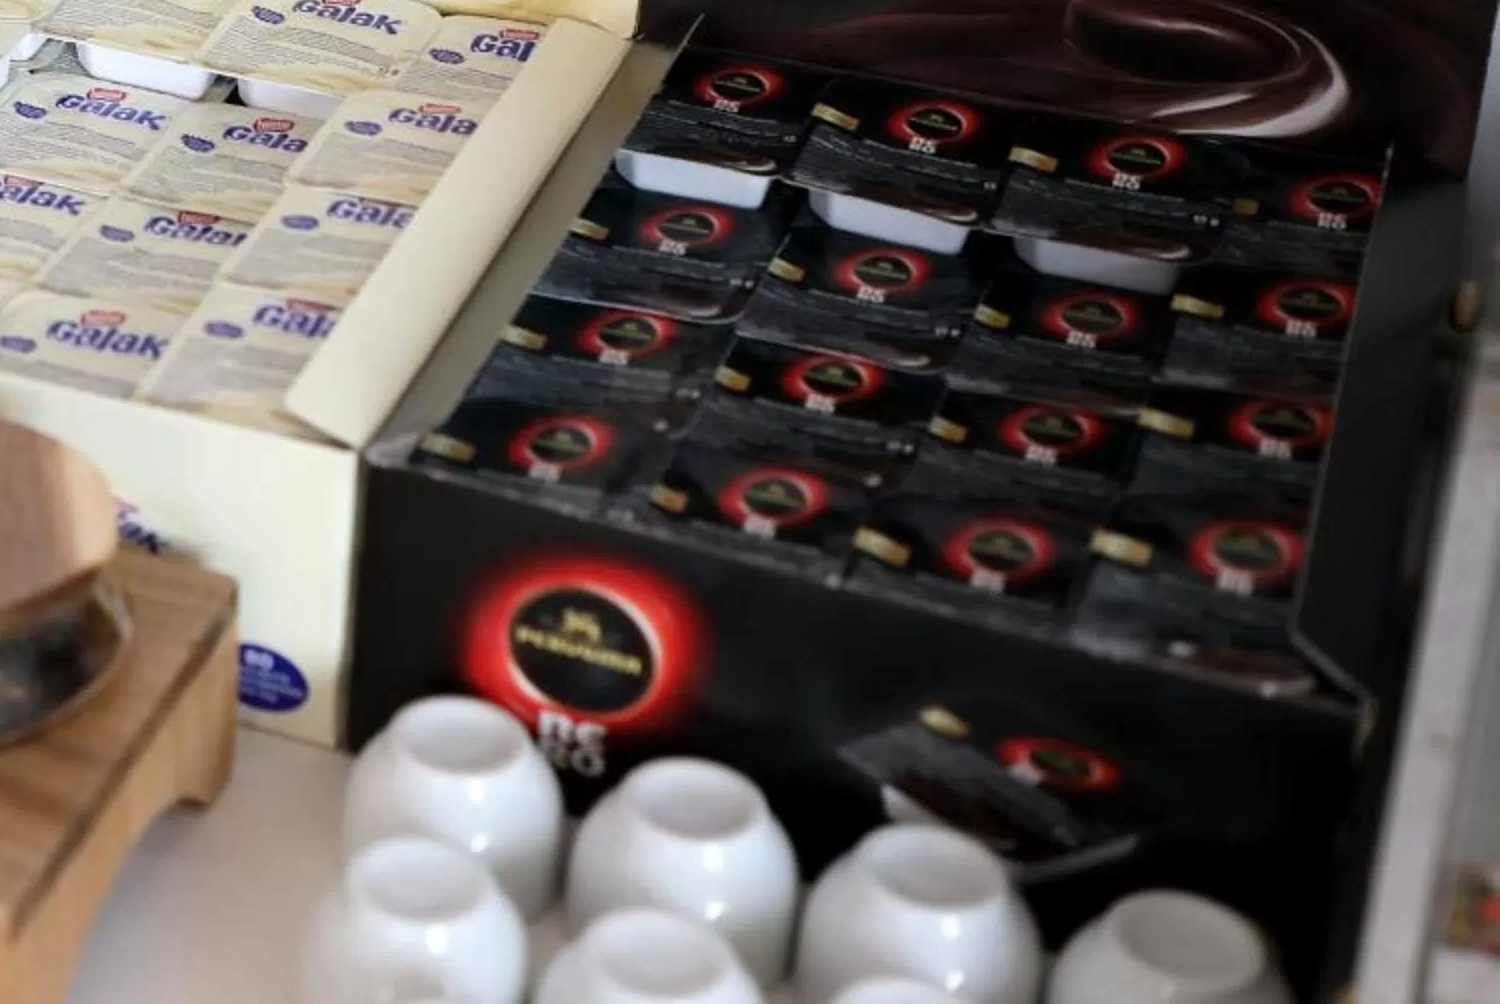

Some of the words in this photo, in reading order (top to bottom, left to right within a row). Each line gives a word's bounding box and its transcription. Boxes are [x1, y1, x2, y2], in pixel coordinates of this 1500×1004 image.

[470, 32, 537, 63] Gal
[55, 94, 167, 131] Galak
[388, 108, 479, 136] Gala
[222, 124, 309, 153] Gala
[45, 318, 172, 361] Galak
